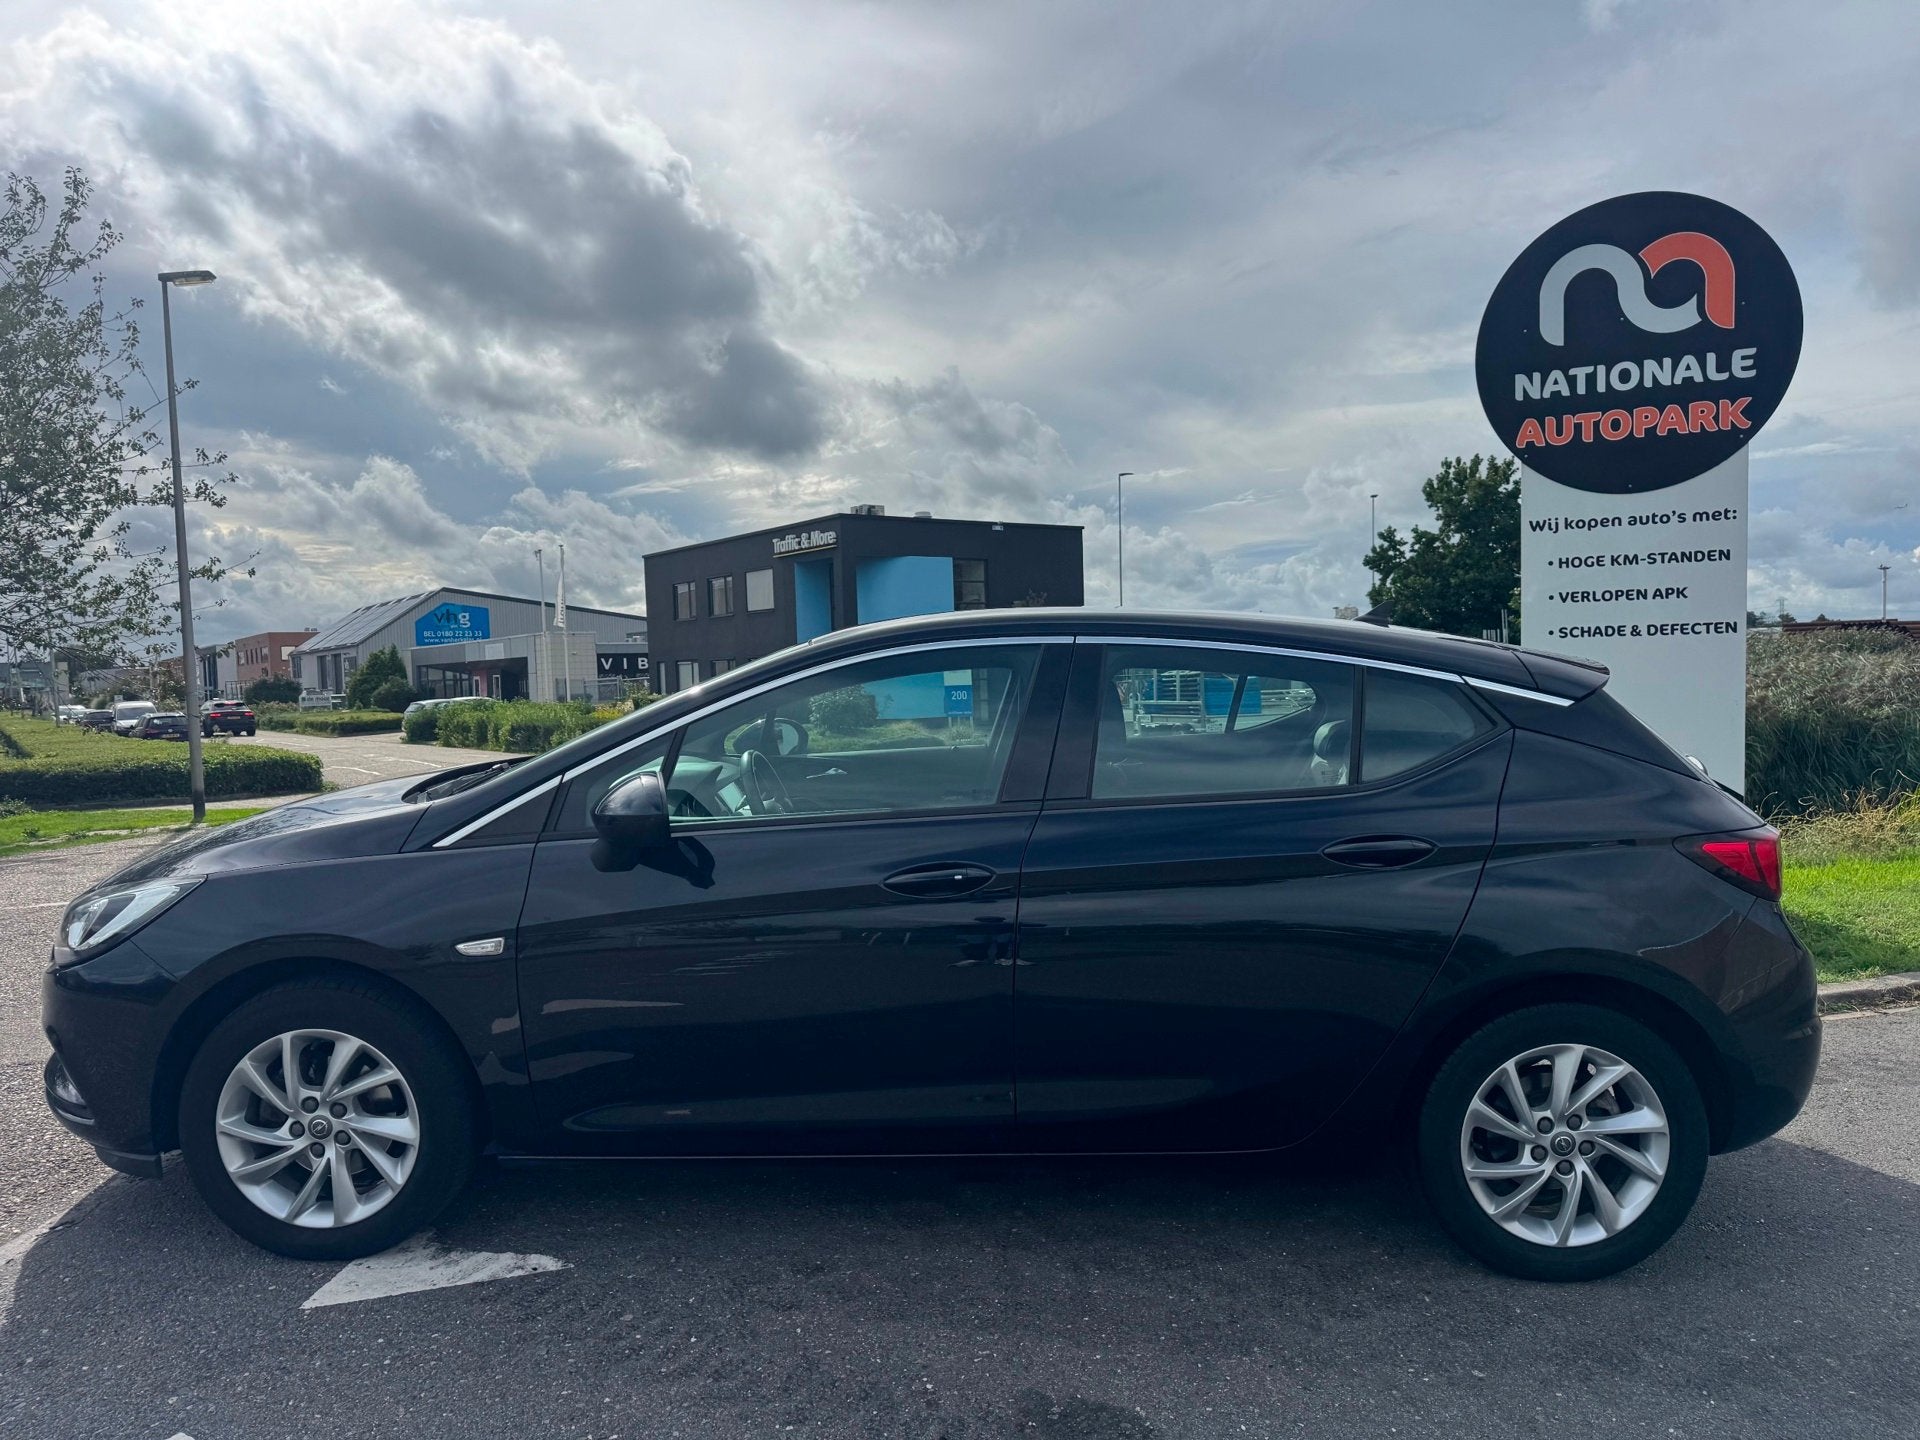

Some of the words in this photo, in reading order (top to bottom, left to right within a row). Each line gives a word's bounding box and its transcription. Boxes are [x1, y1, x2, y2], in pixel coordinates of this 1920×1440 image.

[1514, 347, 1757, 401] NATIONALE
[1515, 397, 1753, 449] AUTOPARK
[1529, 517, 1559, 534] Wij
[1564, 516, 1622, 531] kopen
[1627, 510, 1687, 526] auto's
[1692, 507, 1738, 523] met:
[772, 534, 800, 553] Traffic
[800, 533, 809, 549] &
[810, 531, 837, 547] More
[1558, 555, 1606, 569] HOGE
[1610, 549, 1731, 567] KM-STANDEN
[1558, 589, 1648, 604] VERLOPEN
[1652, 587, 1688, 600] APK
[434, 608, 471, 628] vhg
[1558, 625, 1627, 638] SCHADE
[1630, 624, 1642, 637] &
[1646, 621, 1738, 637] DEFECTEN
[951, 690, 968, 700] 200
